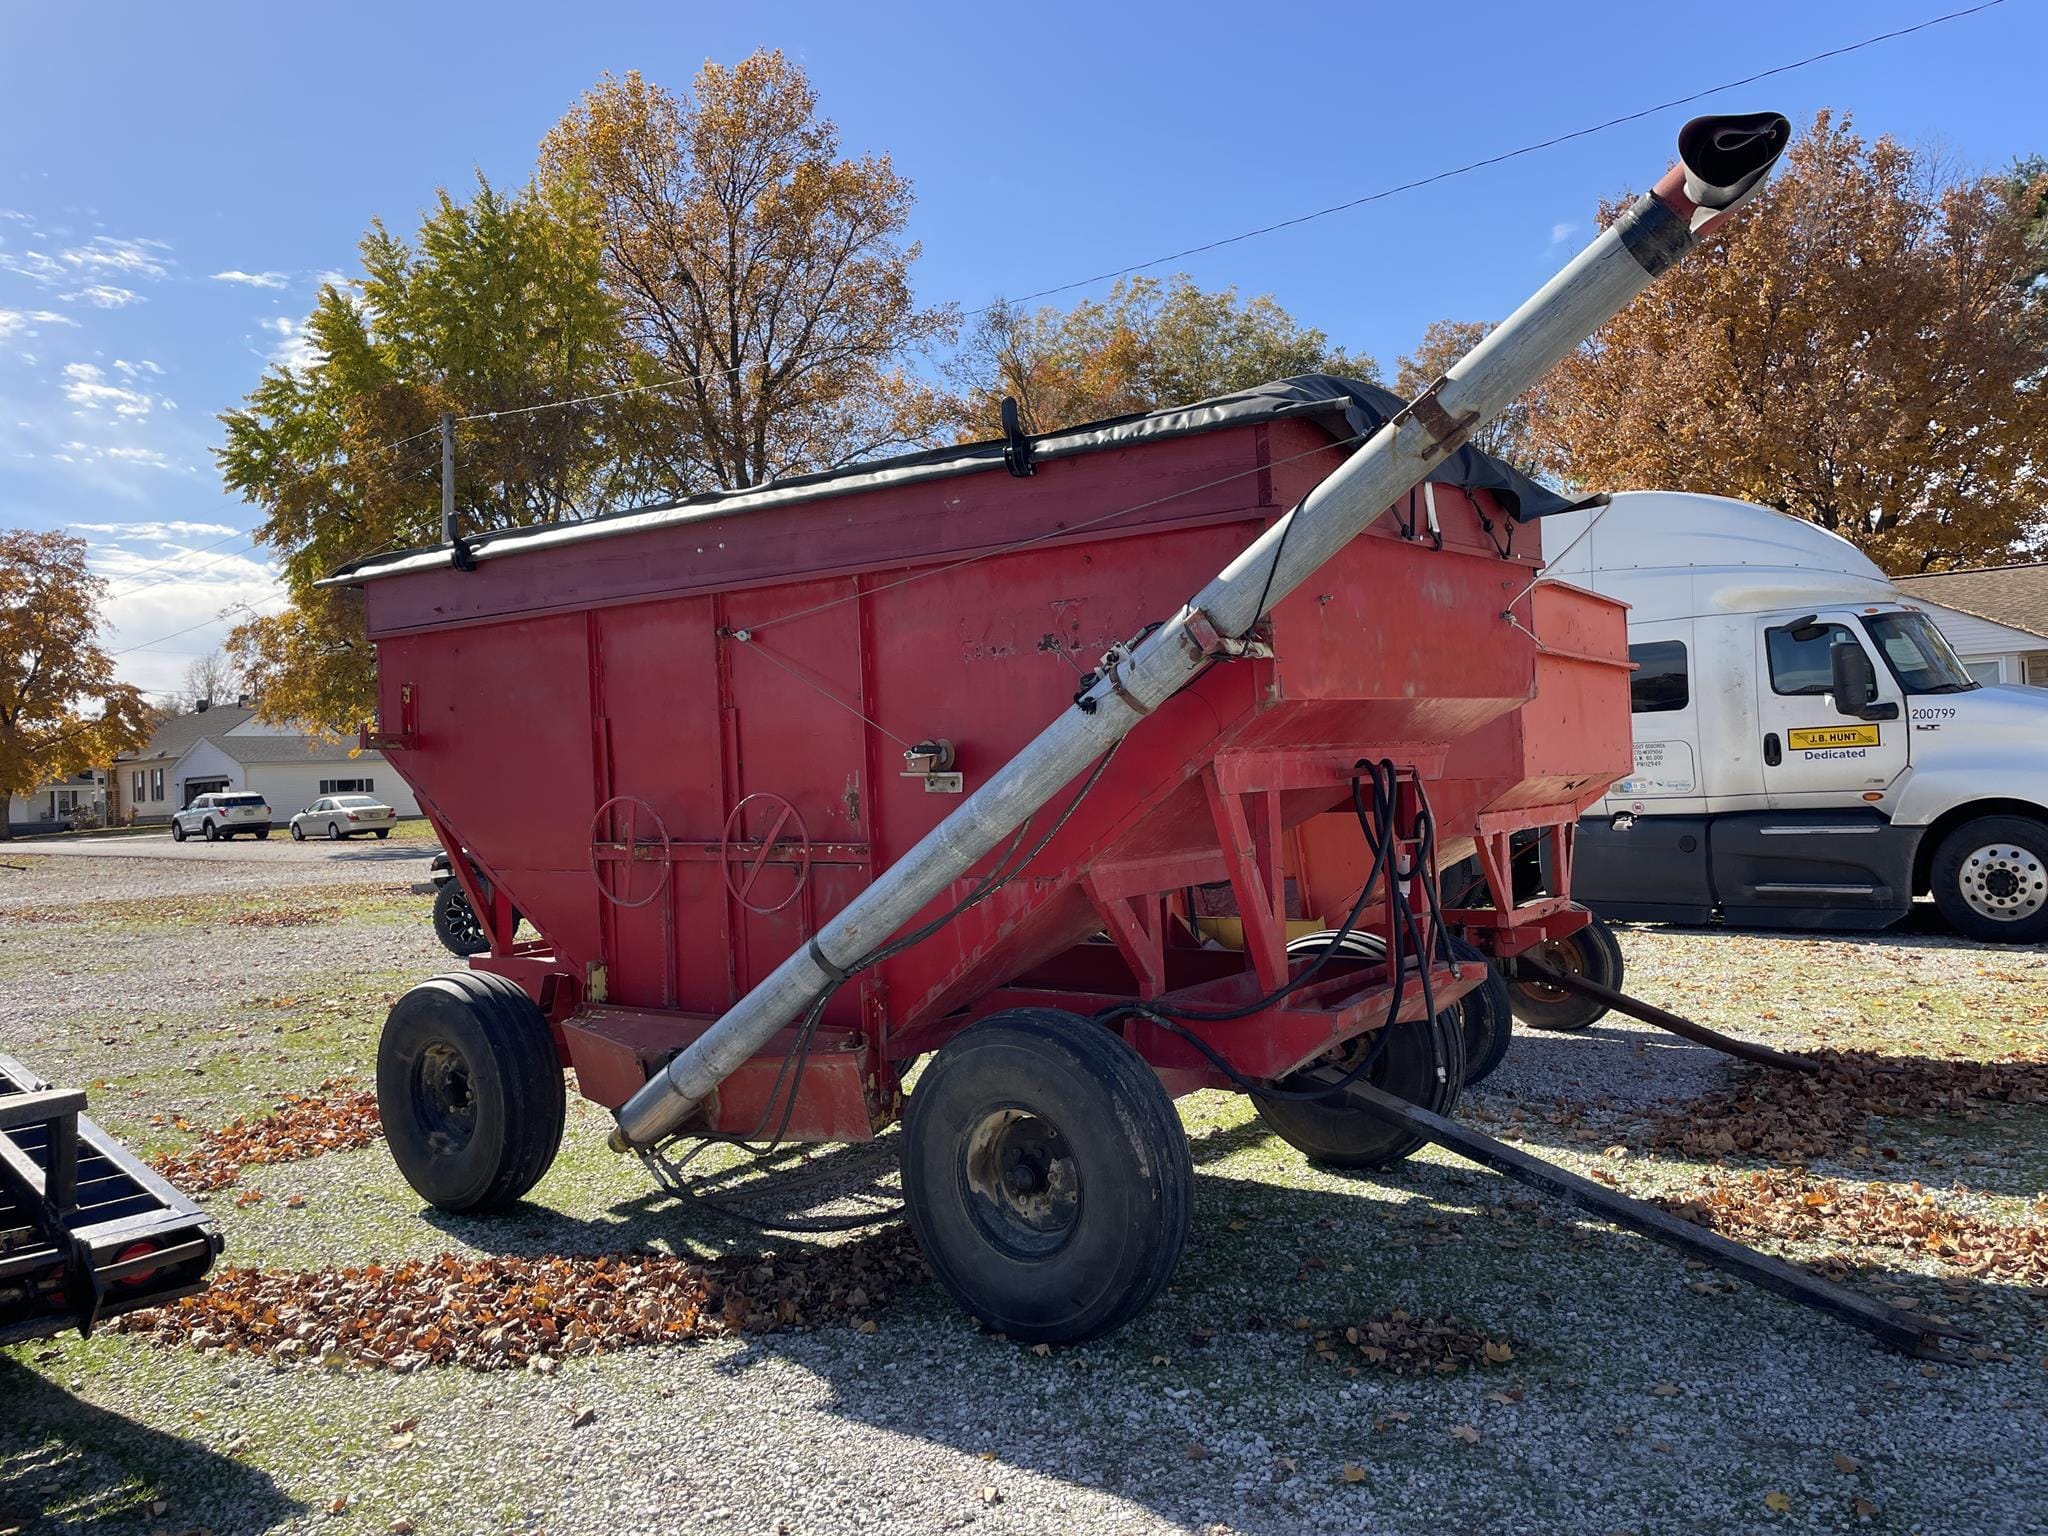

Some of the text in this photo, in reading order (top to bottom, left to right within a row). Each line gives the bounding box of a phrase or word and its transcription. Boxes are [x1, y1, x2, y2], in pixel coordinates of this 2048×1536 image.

[1912, 708, 1956, 719] 200799
[1830, 733, 1857, 742] HUNT
[1804, 749, 1866, 760] Dedicated
